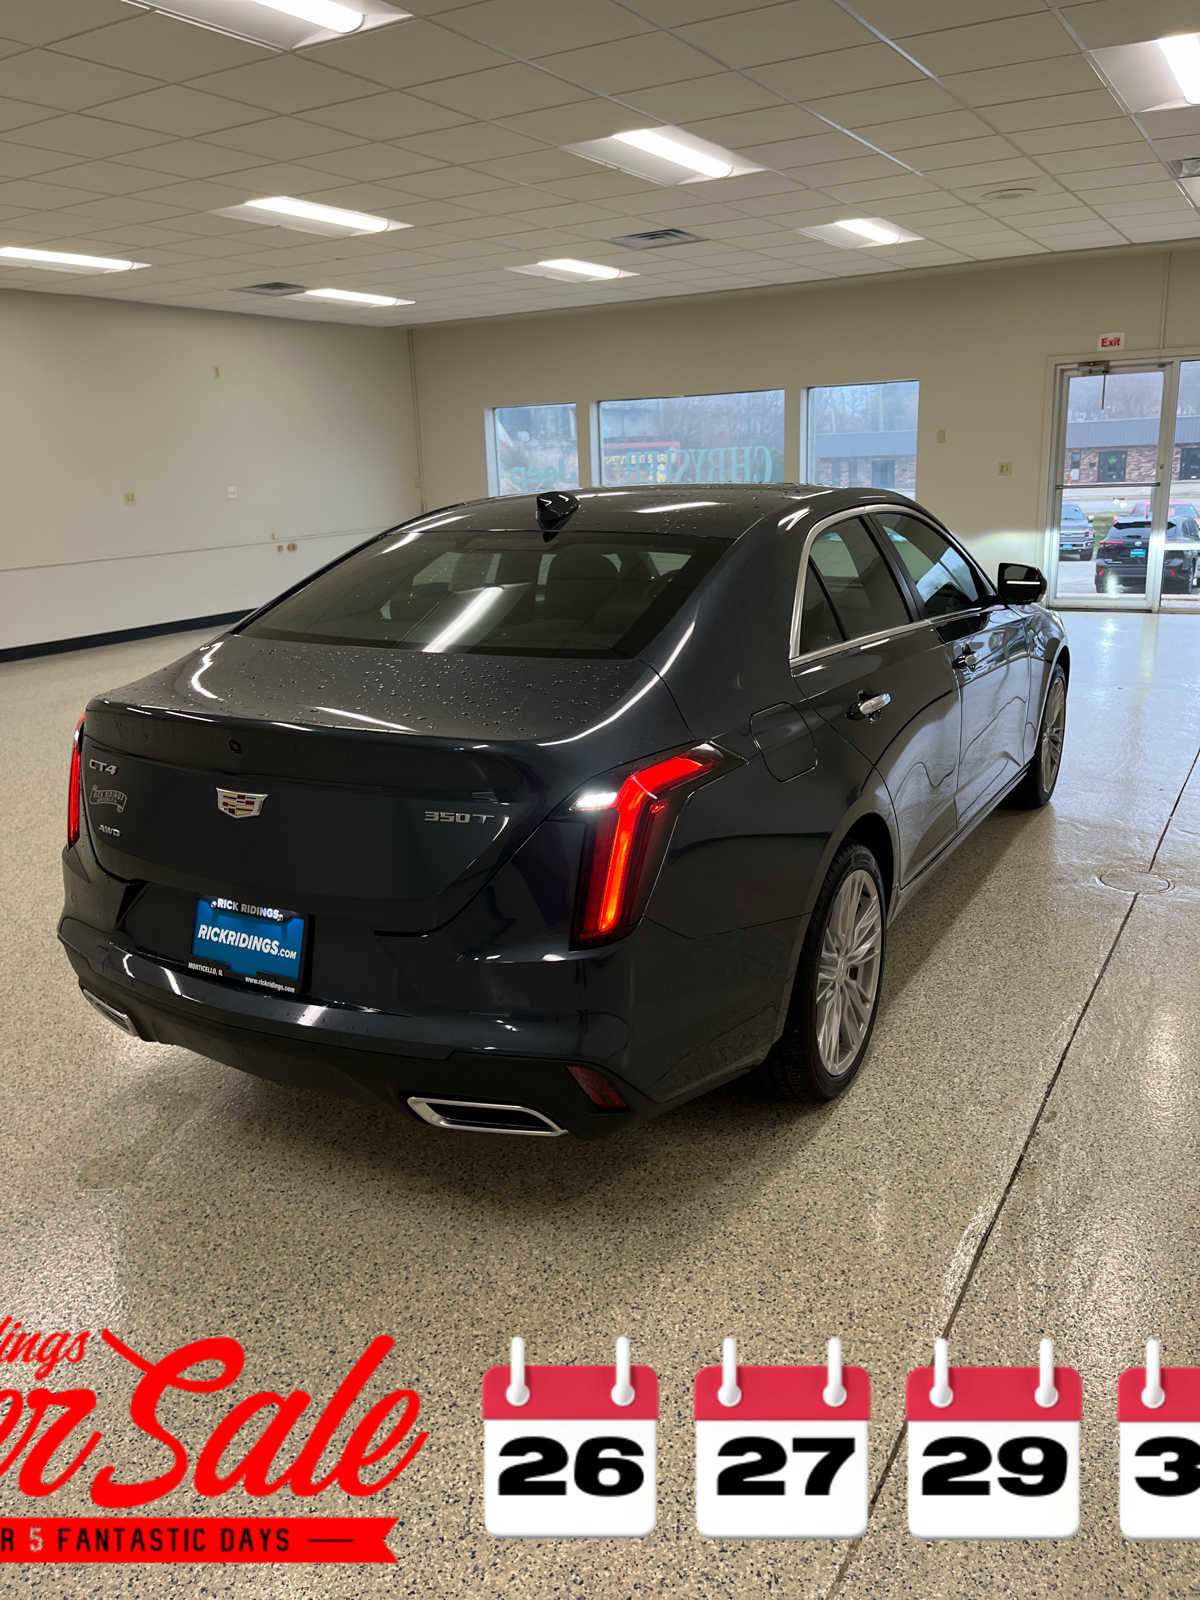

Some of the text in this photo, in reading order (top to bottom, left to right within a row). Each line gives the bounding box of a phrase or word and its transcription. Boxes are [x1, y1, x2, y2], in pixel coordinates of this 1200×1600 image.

[1101, 336, 1121, 348] Exit
[89, 759, 118, 775] CT4
[99, 824, 121, 837] AWD
[217, 898, 280, 920] RICK RIDINGS
[197, 924, 297, 960] RICKRIDINGS.COM
